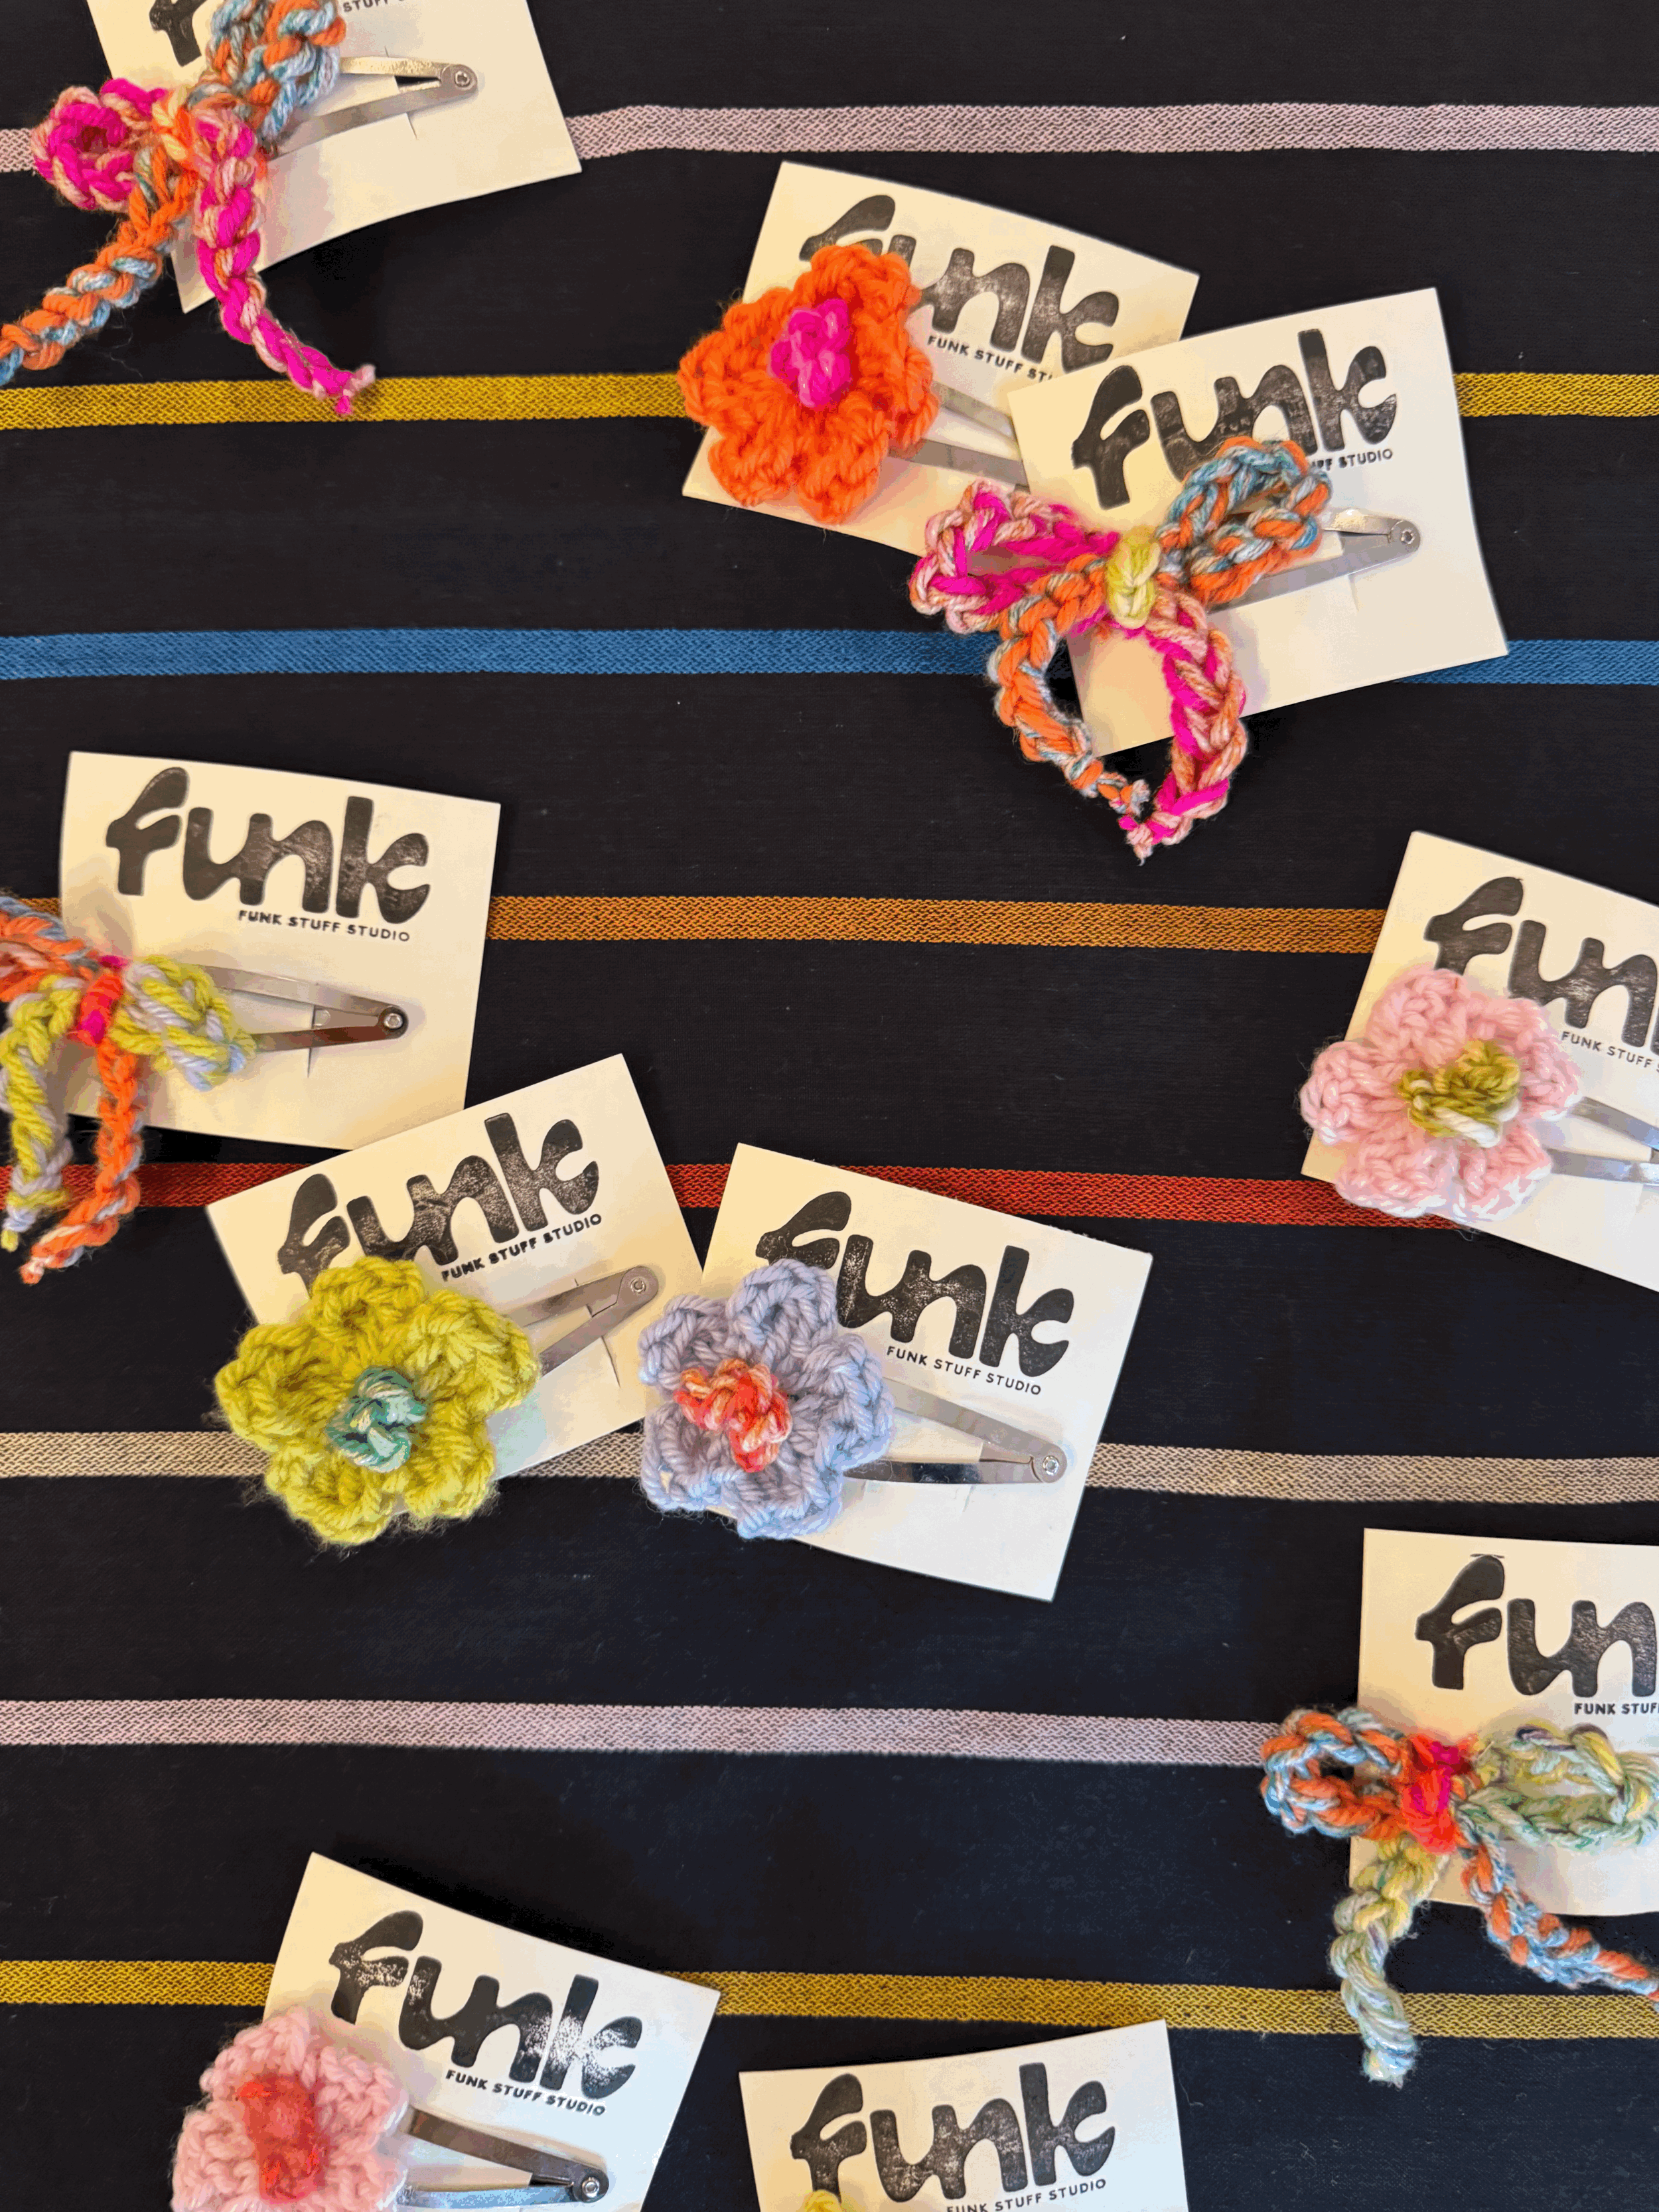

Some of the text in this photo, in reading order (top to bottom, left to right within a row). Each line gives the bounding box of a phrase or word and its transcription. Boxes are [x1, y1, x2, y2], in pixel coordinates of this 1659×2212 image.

[927, 334, 1023, 374] FUNK STUFF
[1071, 329, 1397, 510] funk
[1338, 449, 1393, 469] STUDIO
[106, 767, 431, 924] funk
[238, 910, 410, 942] FUNK STUFF STUDIO
[1423, 876, 1659, 1055] fun
[1561, 1031, 1652, 1068] FUNK STUFF
[277, 1113, 599, 1300] funk
[441, 1213, 602, 1282] FUNK STUFF STUDIO
[756, 1191, 1074, 1377] funk
[887, 1346, 1041, 1395] FUNK STUFF STUDIO
[1415, 1554, 1658, 1698] fun
[1574, 1702, 1659, 1715] FUNK STUF
[329, 1910, 642, 2099] funk
[445, 2069, 606, 2116] FUNK STUFF STUDIO
[790, 2062, 1115, 2202] funk
[995, 2193, 1042, 2211] STUFF
[1049, 2179, 1106, 2201] STUDIO
